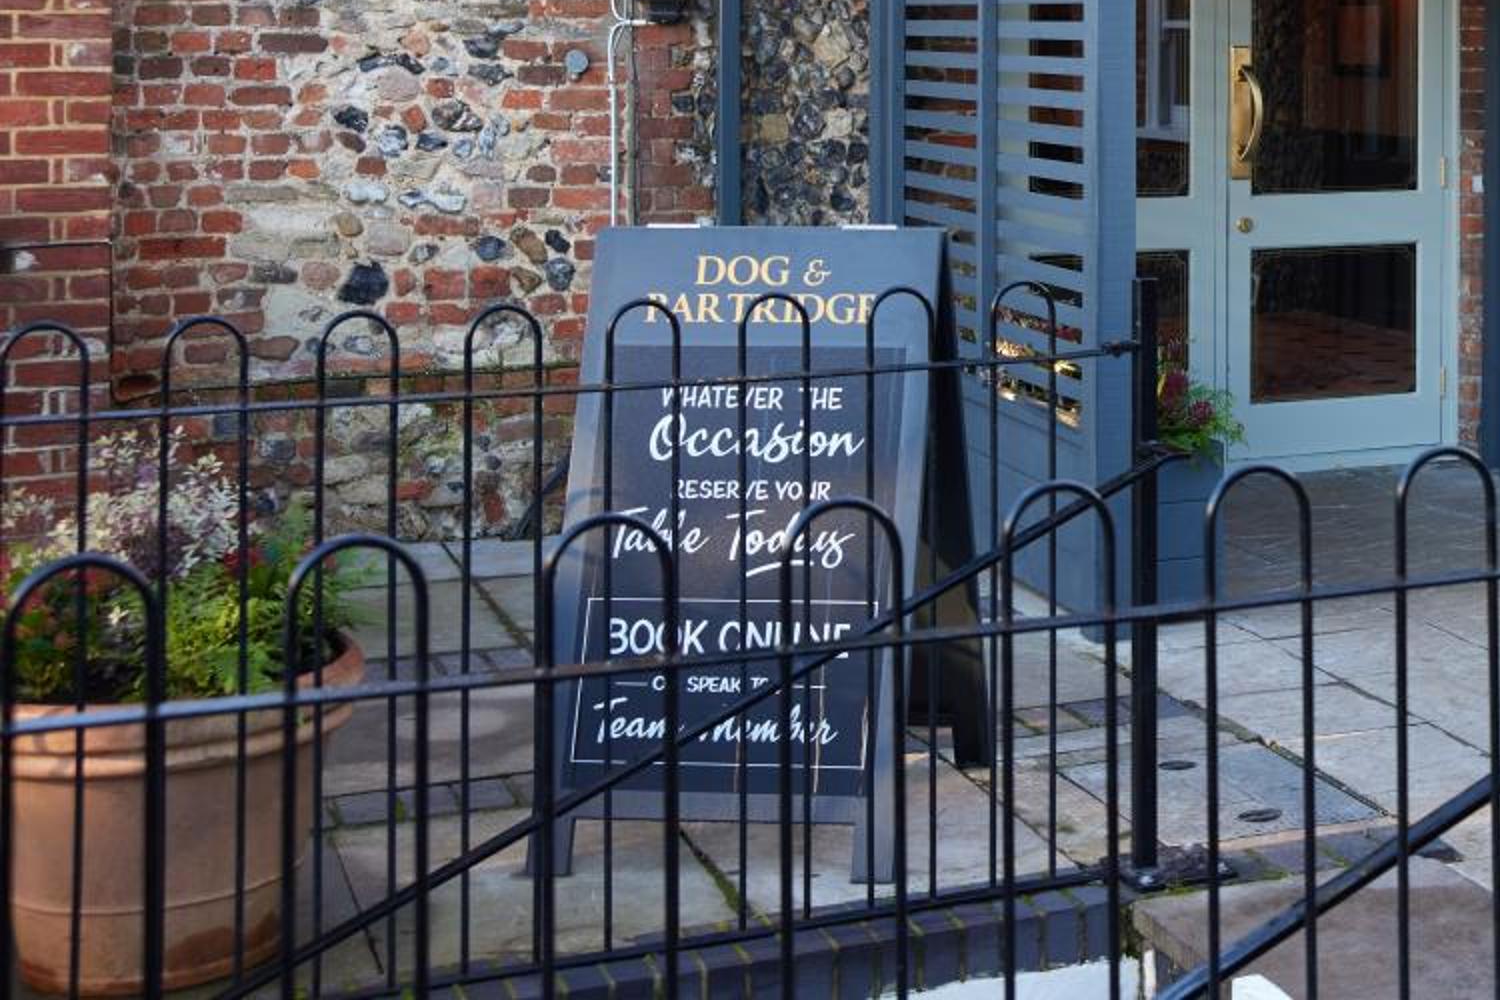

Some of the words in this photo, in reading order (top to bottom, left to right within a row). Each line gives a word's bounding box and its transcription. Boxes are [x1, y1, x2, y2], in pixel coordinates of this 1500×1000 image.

[695, 255, 790, 286] DOG
[802, 258, 832, 286] &
[649, 412, 865, 464] Occasion
[686, 676, 741, 694] SPEAK
